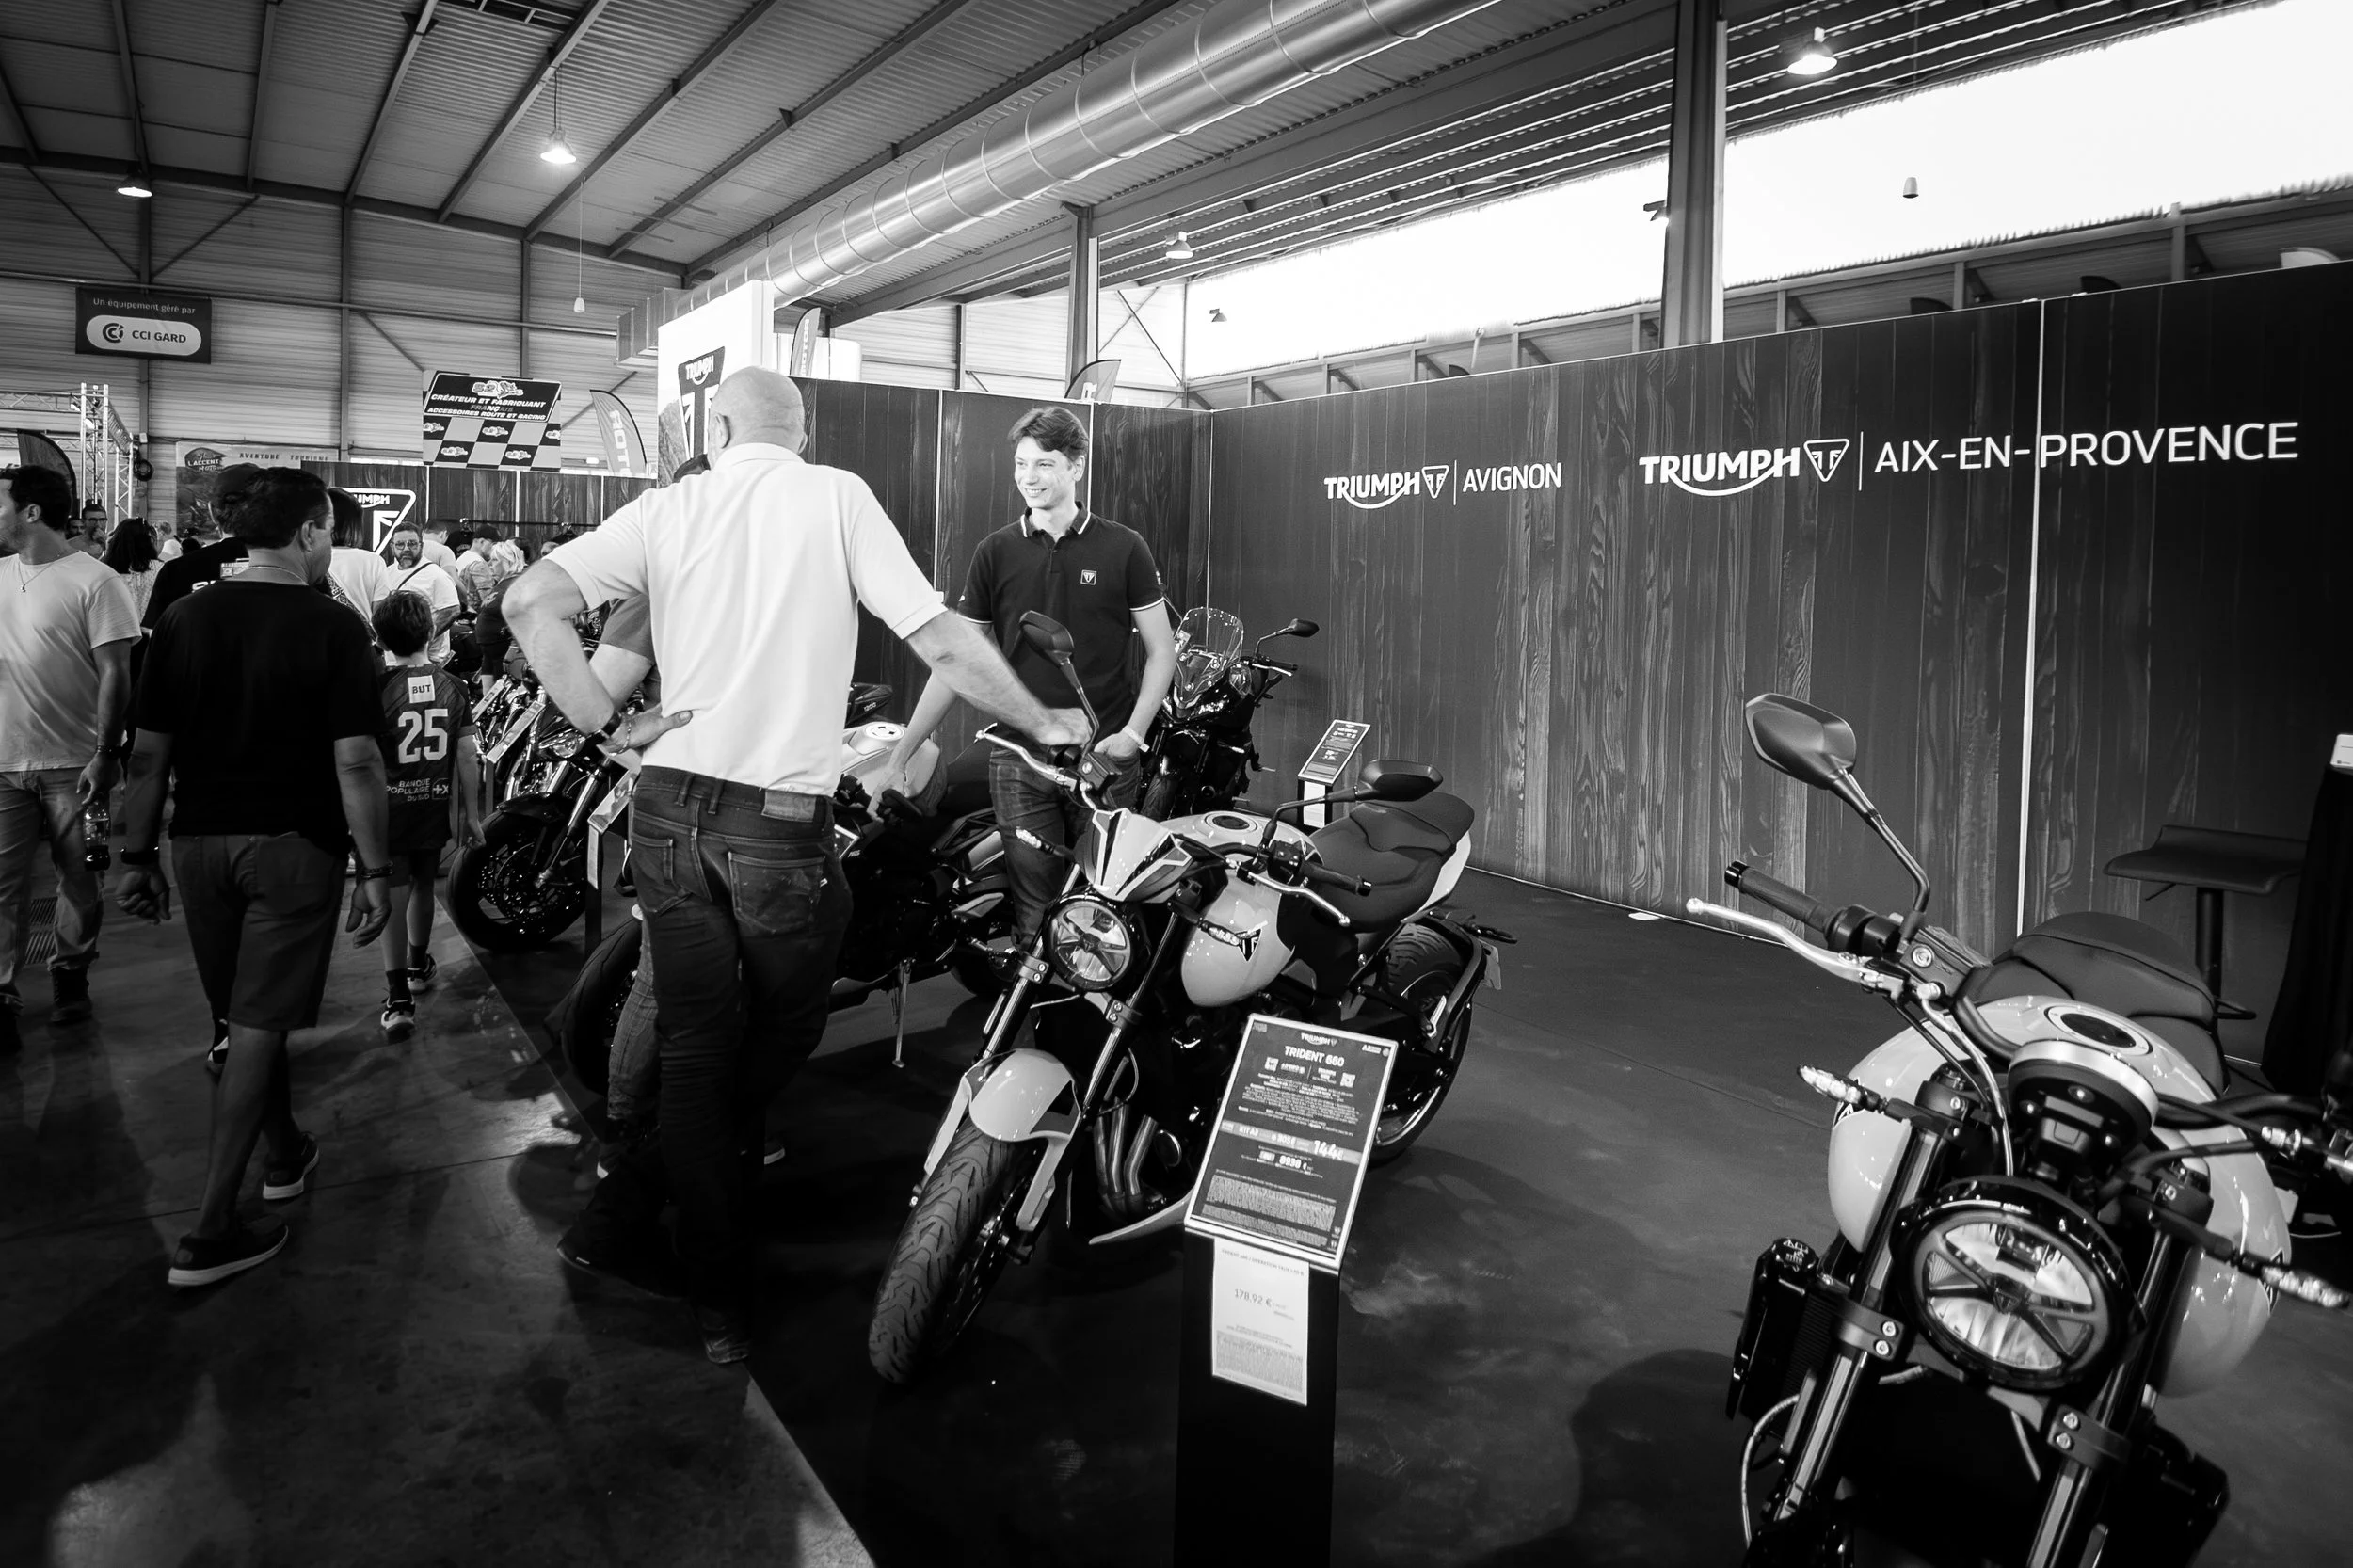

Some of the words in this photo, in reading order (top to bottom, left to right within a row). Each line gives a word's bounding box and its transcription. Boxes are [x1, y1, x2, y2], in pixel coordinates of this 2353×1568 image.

[93, 297, 105, 306] Un
[107, 300, 159, 311] équipement
[132, 329, 151, 340] CCI
[153, 331, 187, 344] GARD
[685, 354, 714, 386] TRIUMPH
[430, 393, 477, 405] CRÉATEUR
[427, 407, 480, 416] ACCESSOIRES
[1639, 447, 1801, 497] TRIUMPH
[1874, 421, 2300, 473] AIX-EN-PROVENCE
[1323, 470, 1421, 510] TRIUMPH
[1462, 461, 1563, 492] AVIGNON
[411, 684, 432, 695] BUT
[397, 708, 449, 764] 25
[398, 777, 431, 788] BANQUE
[1301, 1032, 1330, 1046] TRIUMPH
[1284, 1045, 1325, 1064] TRIDENT
[1325, 1054, 1345, 1067] 660
